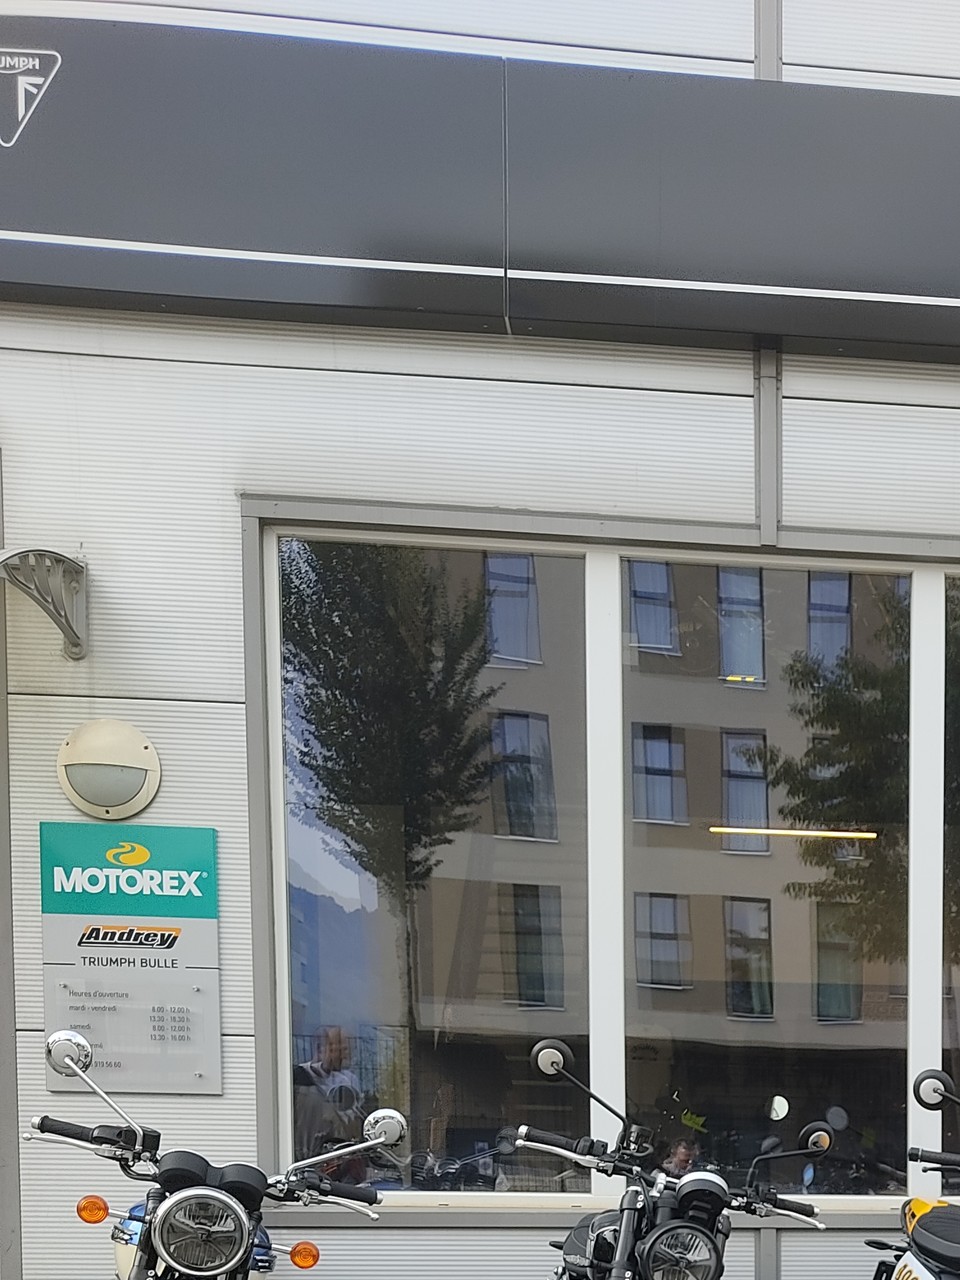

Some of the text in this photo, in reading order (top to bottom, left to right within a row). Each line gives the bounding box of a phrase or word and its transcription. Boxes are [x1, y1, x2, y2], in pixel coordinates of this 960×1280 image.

[53, 867, 203, 897] MOTOREX
[84, 926, 174, 949] Andrey
[81, 956, 178, 968] TRIUMPH BULLE
[69, 990, 129, 999] Heures d'ouverture
